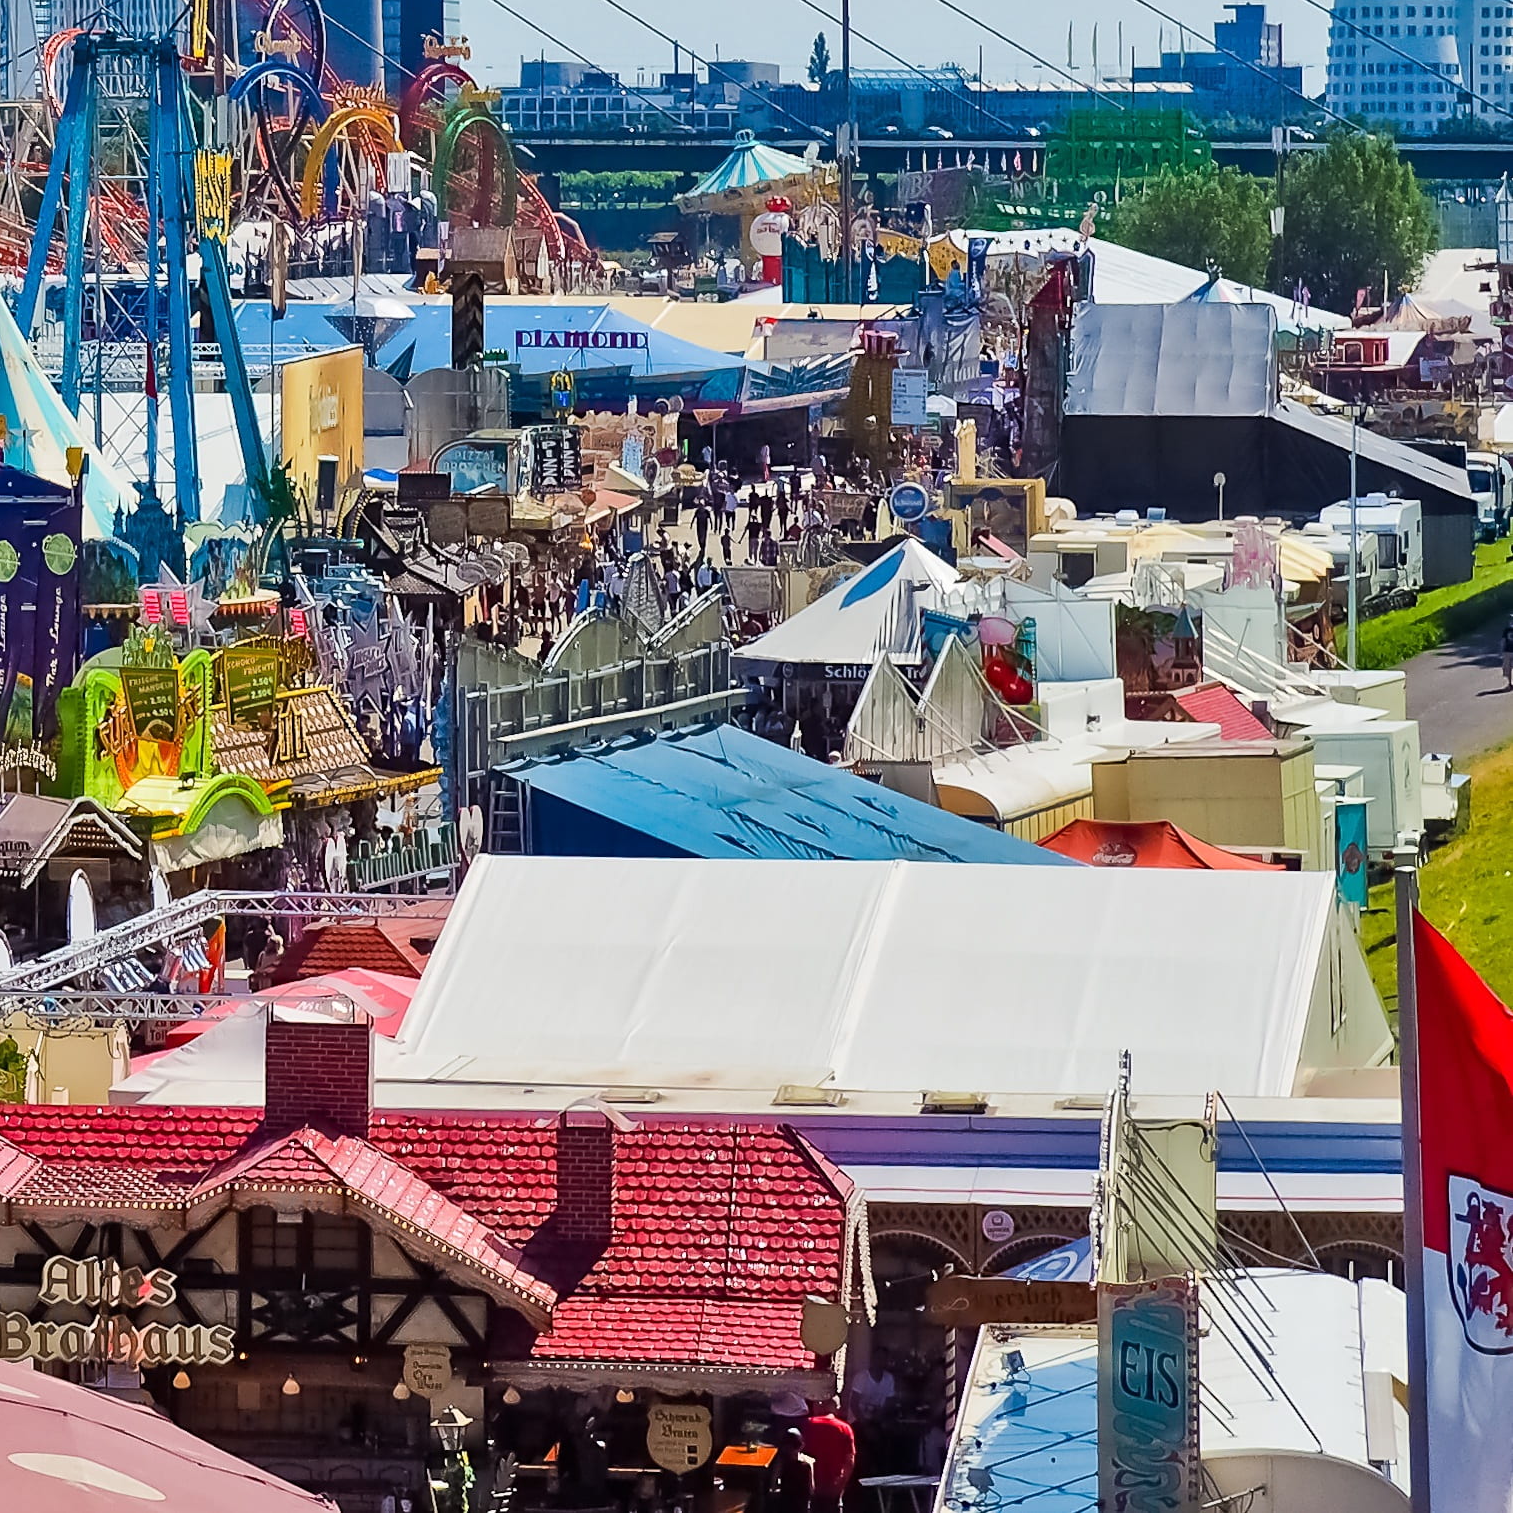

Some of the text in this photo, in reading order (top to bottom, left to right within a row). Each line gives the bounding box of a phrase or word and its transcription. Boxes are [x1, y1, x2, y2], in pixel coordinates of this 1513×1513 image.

[515, 330, 649, 348] DIAMOND
[541, 441, 558, 486] PIZZA
[39, 1255, 177, 1307] Altes
[1119, 1339, 1180, 1409] EIS
